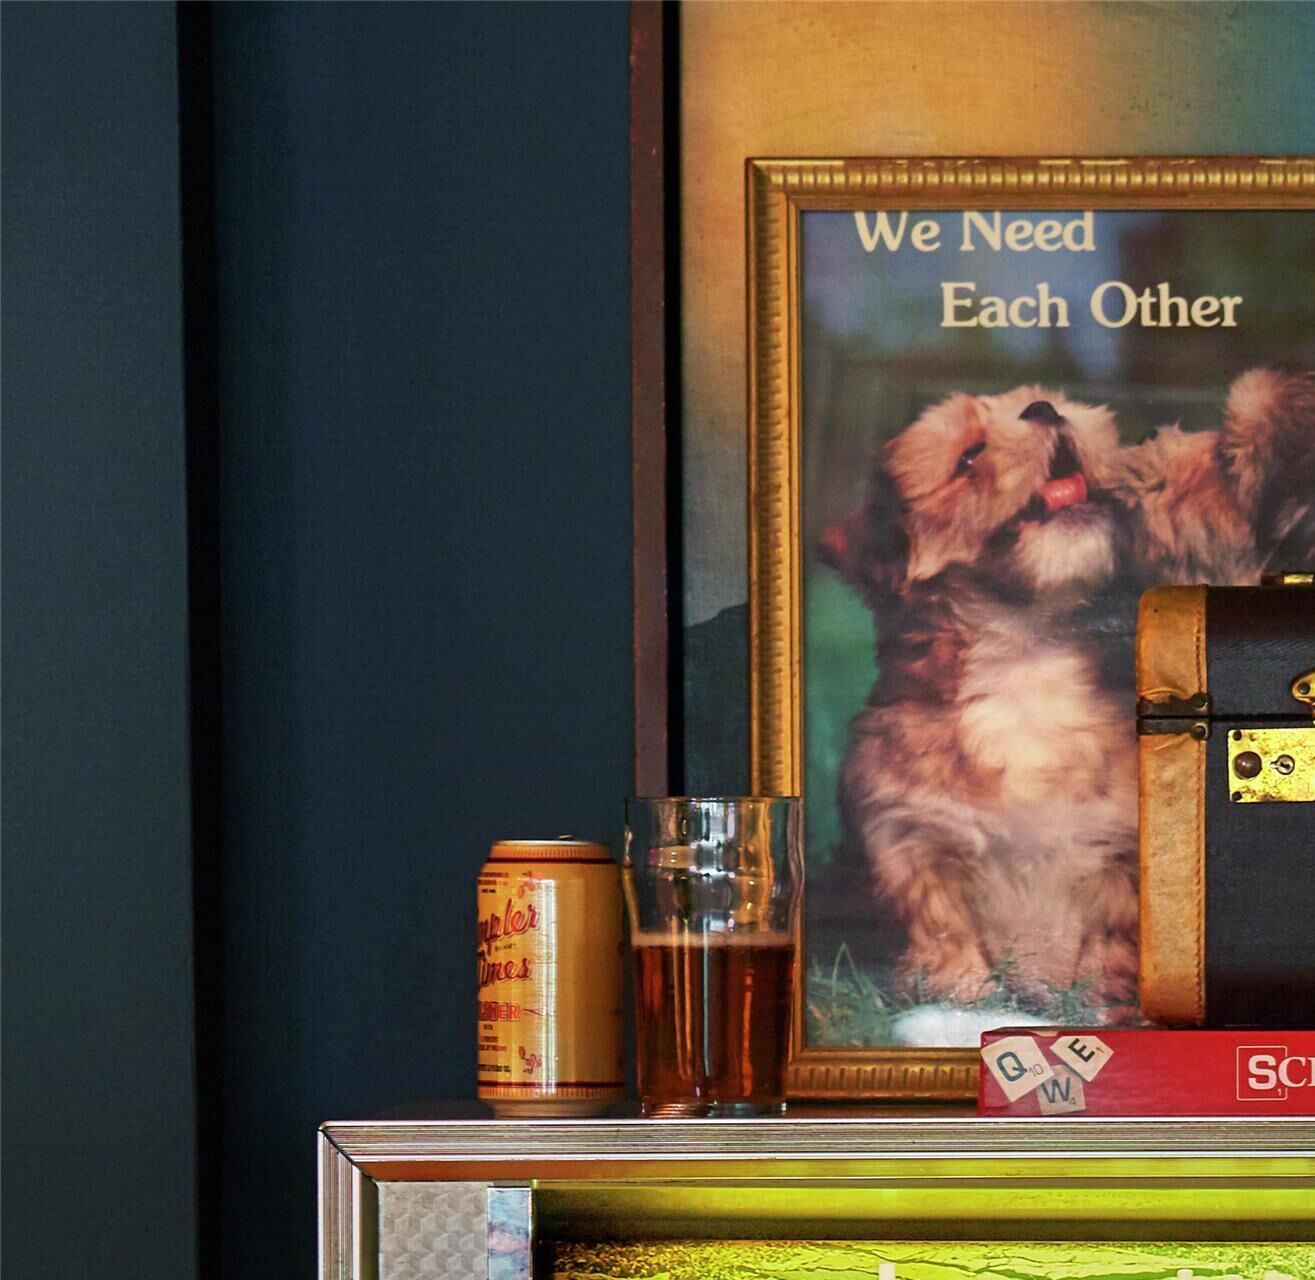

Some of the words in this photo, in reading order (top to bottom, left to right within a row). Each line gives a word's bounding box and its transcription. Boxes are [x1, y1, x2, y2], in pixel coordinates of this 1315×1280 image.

[854, 211, 940, 252] We
[960, 211, 1095, 252] Need
[940, 281, 1070, 328] Each
[1090, 280, 1243, 328] Other
[1068, 1038, 1095, 1062] E
[996, 1051, 1028, 1082] Q
[1041, 1077, 1071, 1103] W
